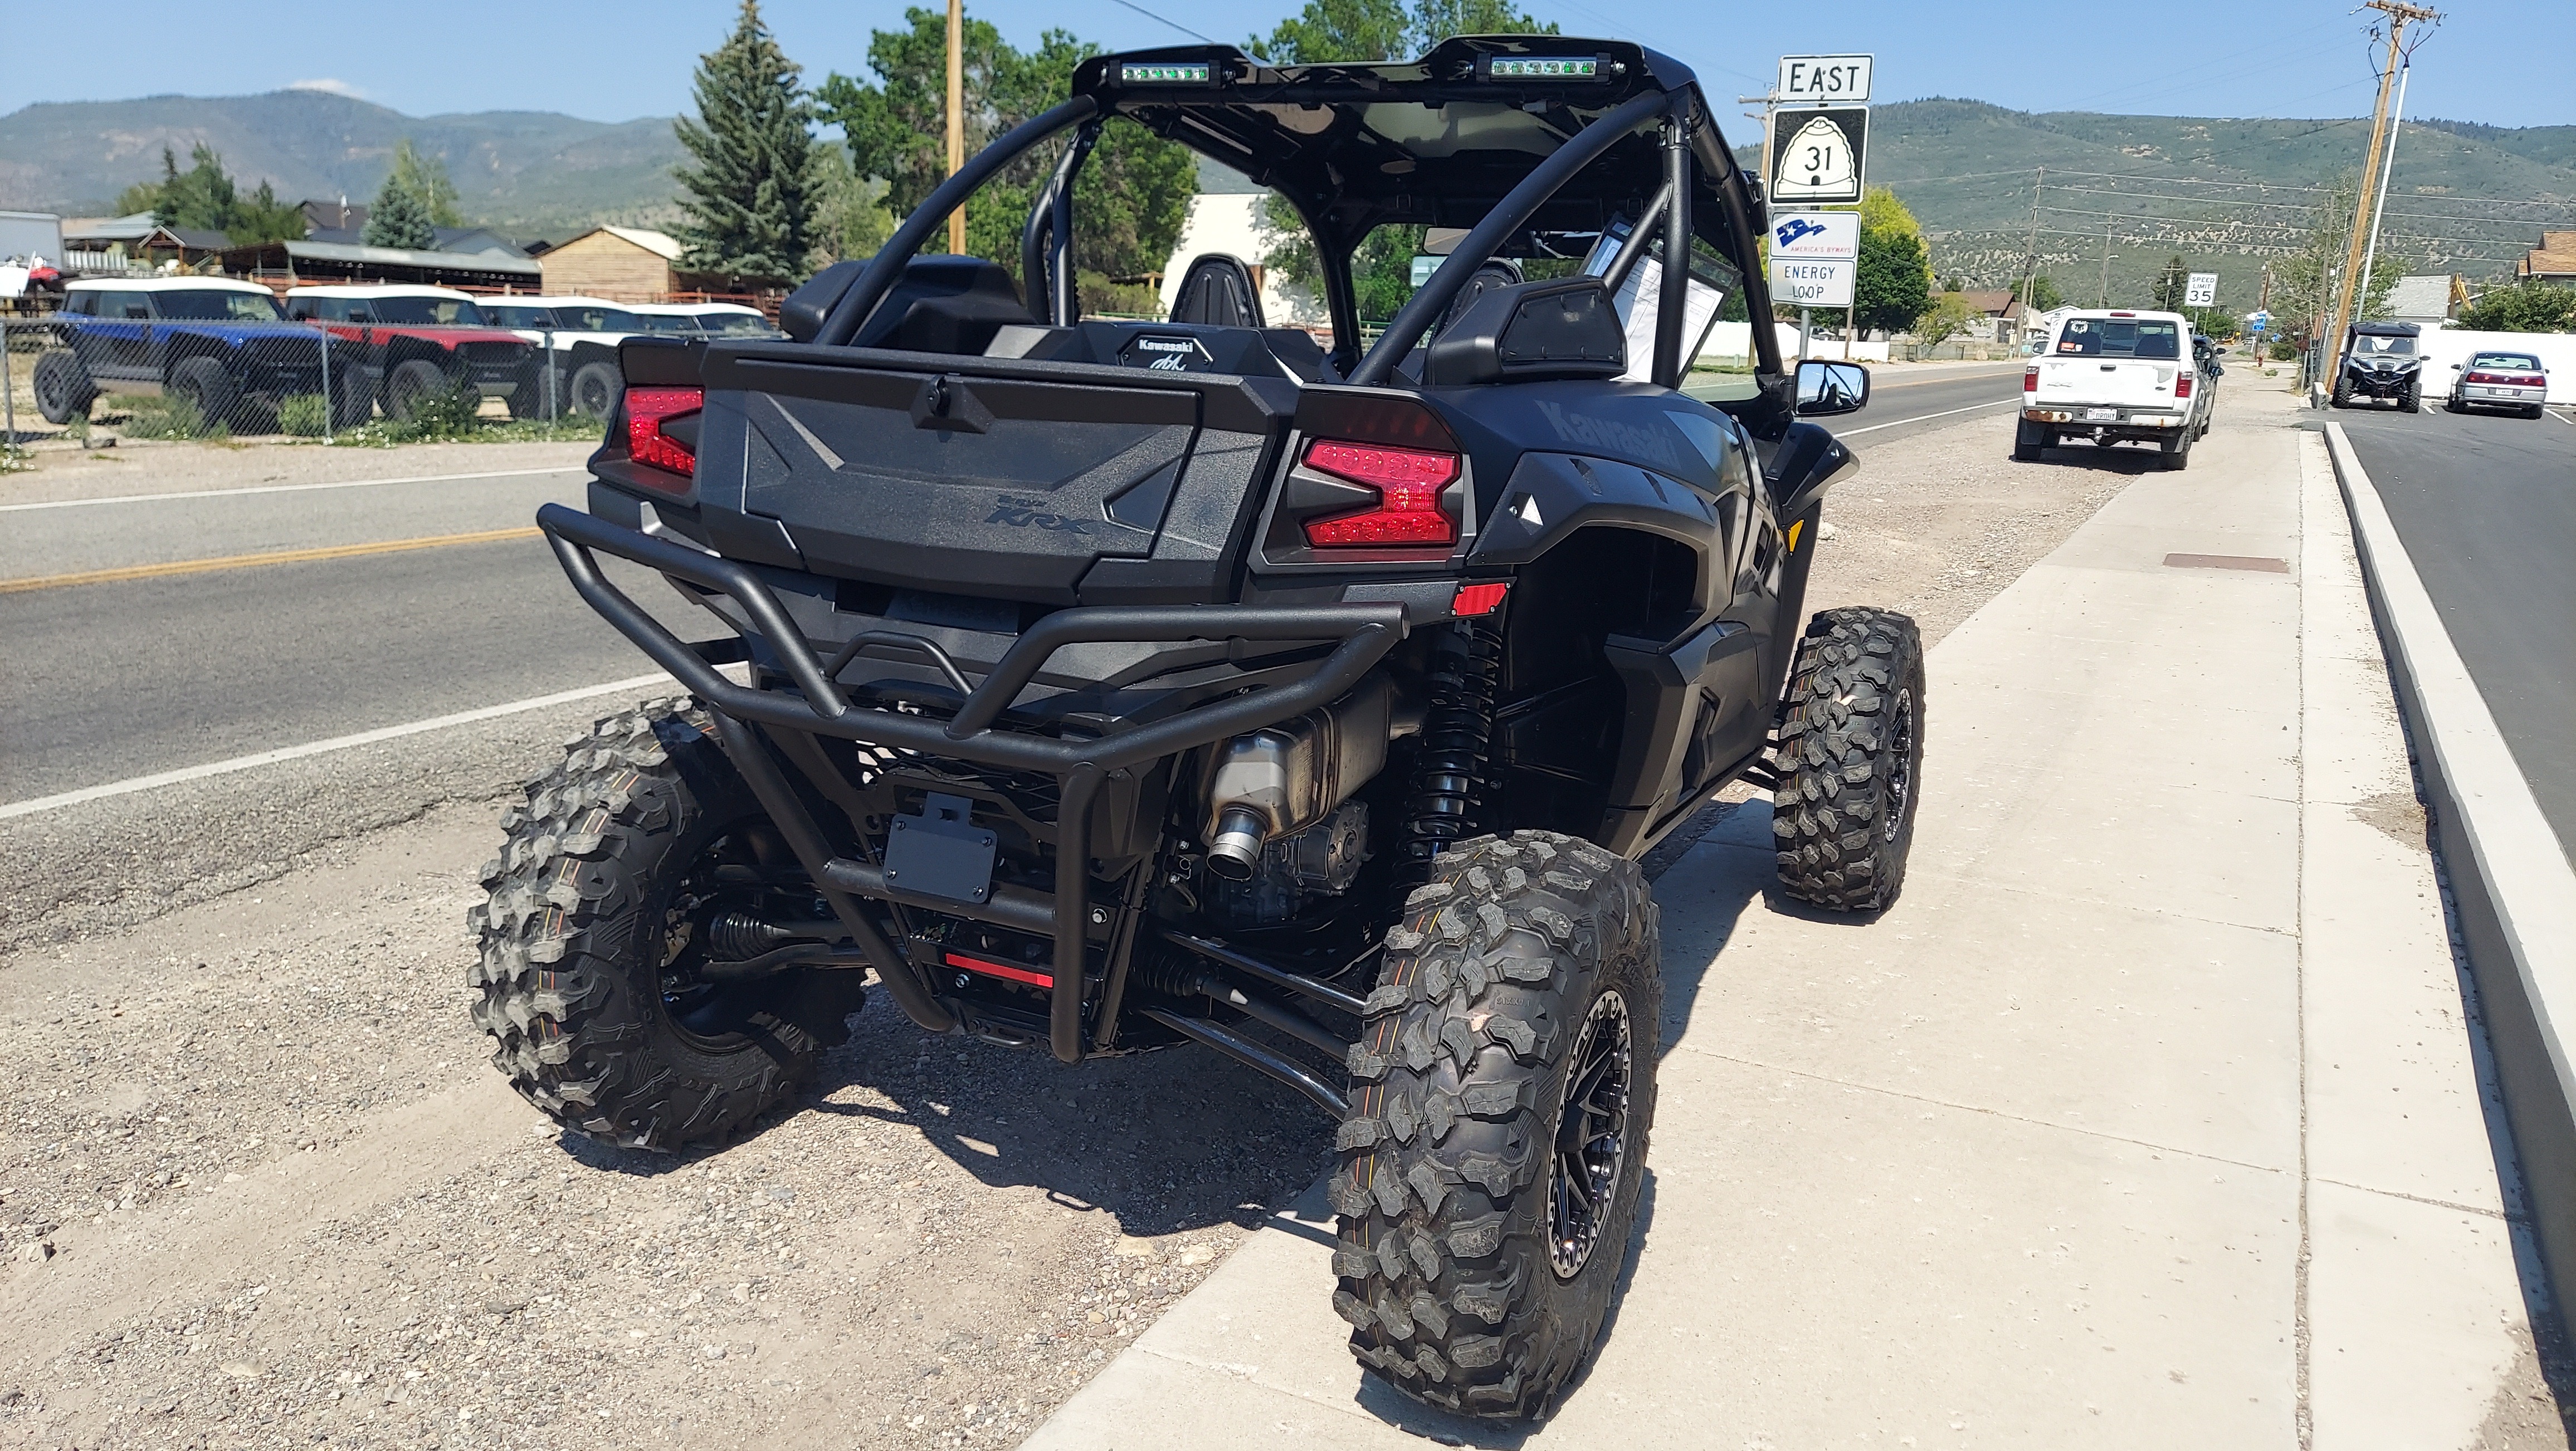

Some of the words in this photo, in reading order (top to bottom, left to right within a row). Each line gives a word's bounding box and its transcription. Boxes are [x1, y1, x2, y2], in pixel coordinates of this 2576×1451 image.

[1790, 63, 1860, 92] EAST
[1804, 146, 1831, 171] 31
[1784, 266, 1836, 280] ENERGY
[1792, 285, 1824, 299] LOOP
[2189, 290, 2212, 303] 35
[1139, 339, 1193, 353] Kawasaki
[1533, 399, 1682, 470] Kawasaki
[984, 505, 1099, 535] KRX
